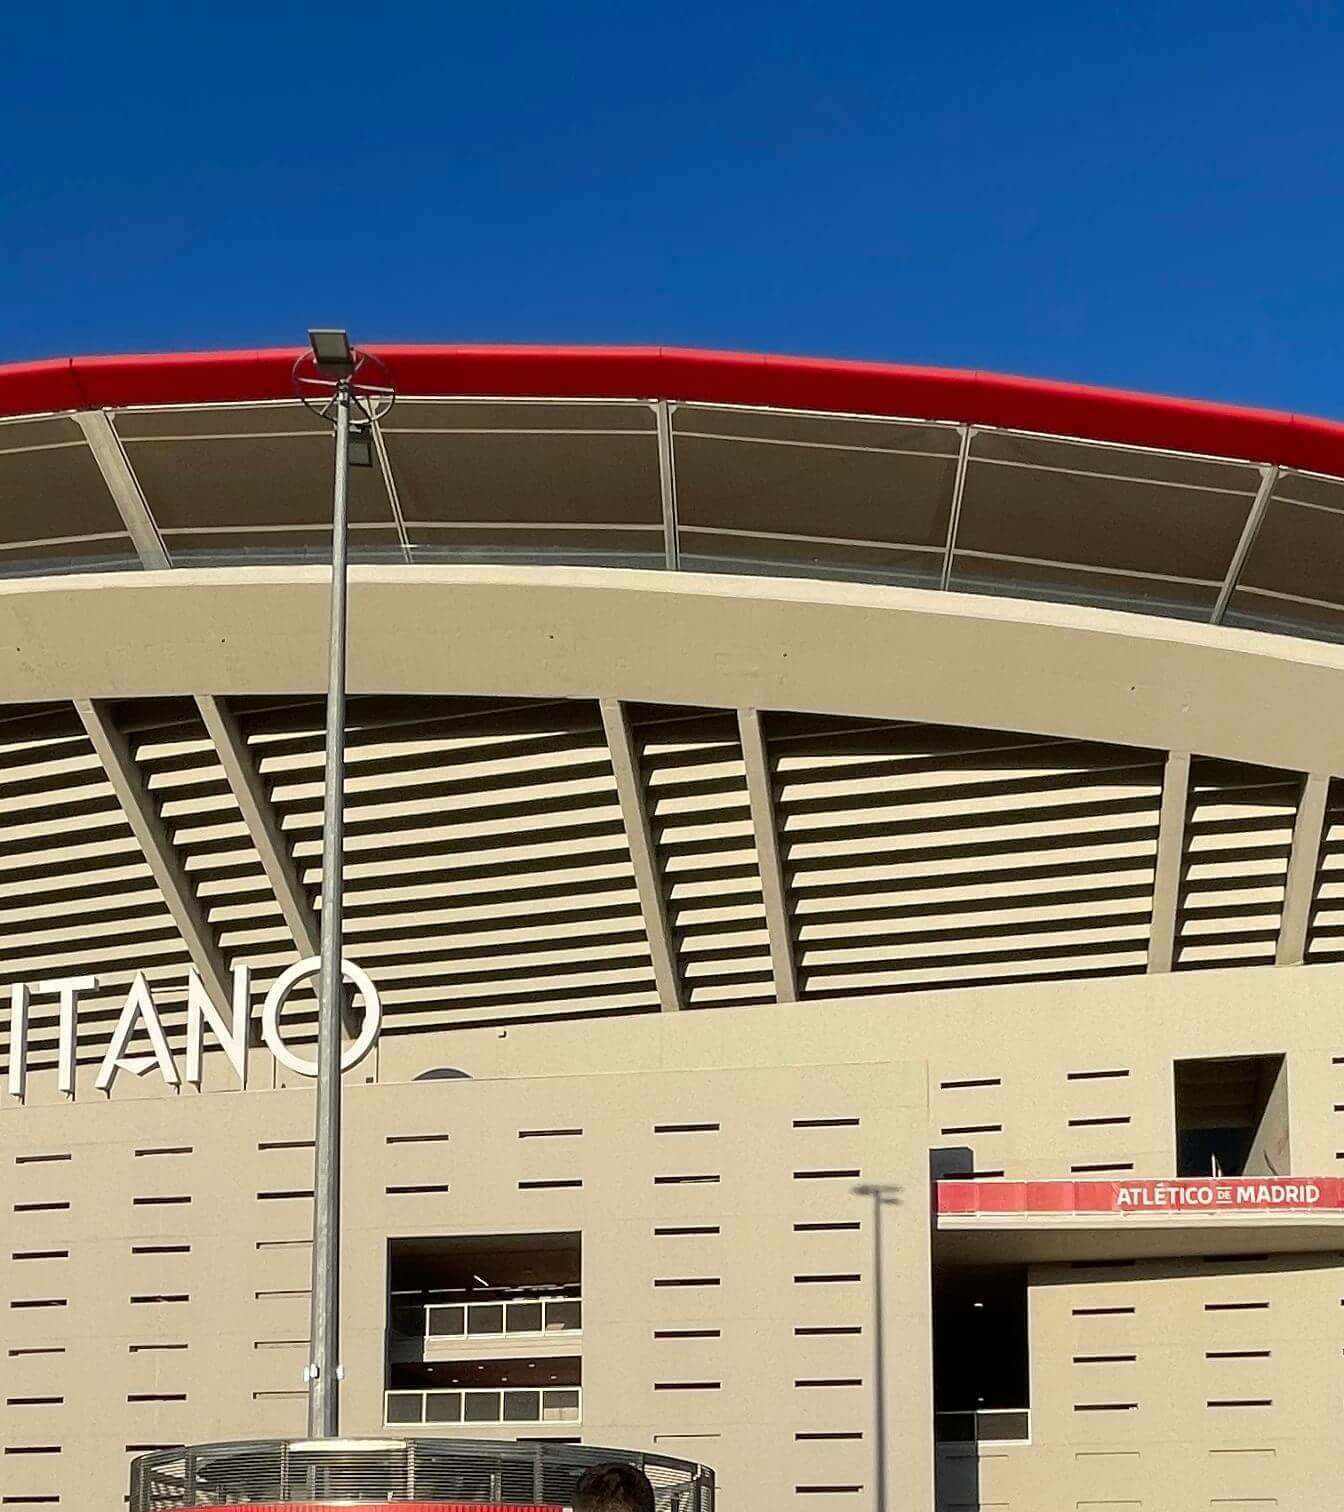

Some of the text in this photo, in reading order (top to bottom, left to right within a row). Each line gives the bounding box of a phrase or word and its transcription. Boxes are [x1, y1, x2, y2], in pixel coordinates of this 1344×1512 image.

[1117, 1183, 1320, 1205] ATLÉTICO DE MADRID
